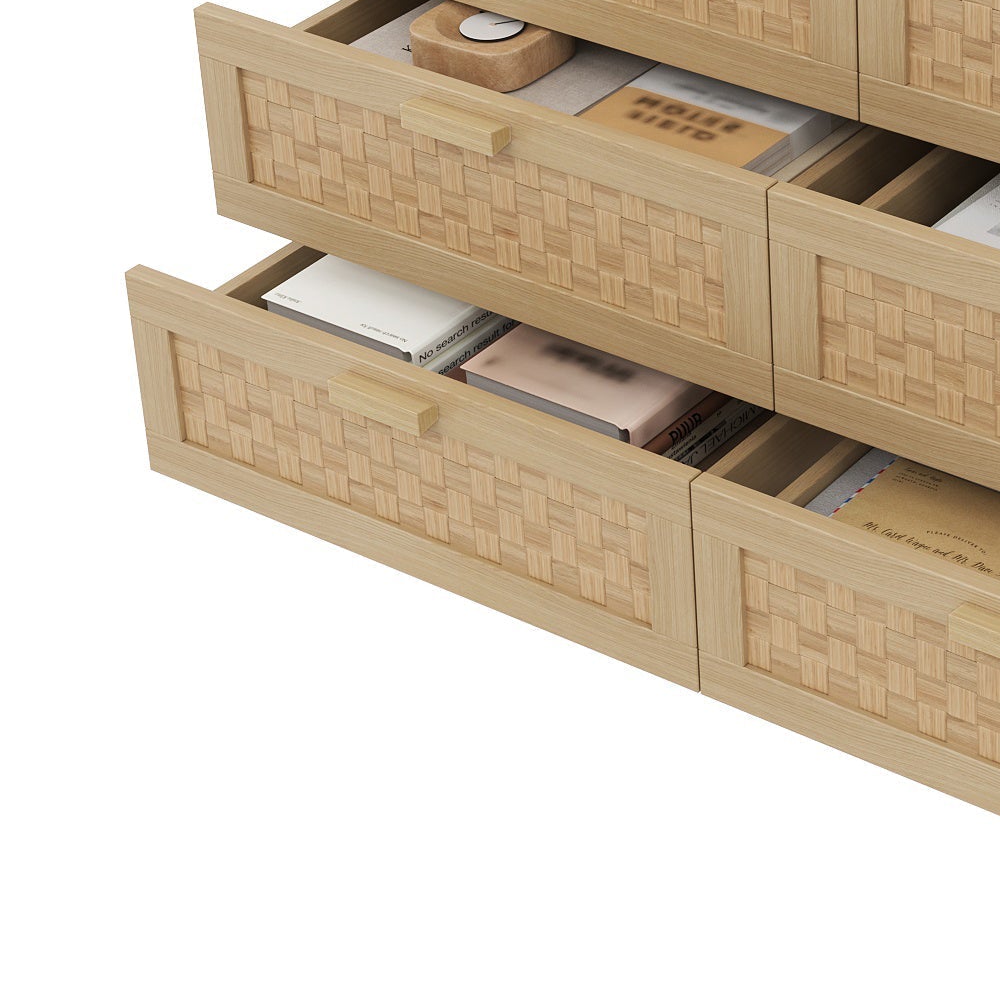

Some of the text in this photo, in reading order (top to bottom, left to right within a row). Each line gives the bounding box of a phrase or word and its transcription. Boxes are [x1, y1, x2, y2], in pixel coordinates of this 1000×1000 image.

[418, 349, 434, 364] No
[436, 324, 469, 352] search
[438, 349, 471, 375] search
[472, 329, 500, 353] result
